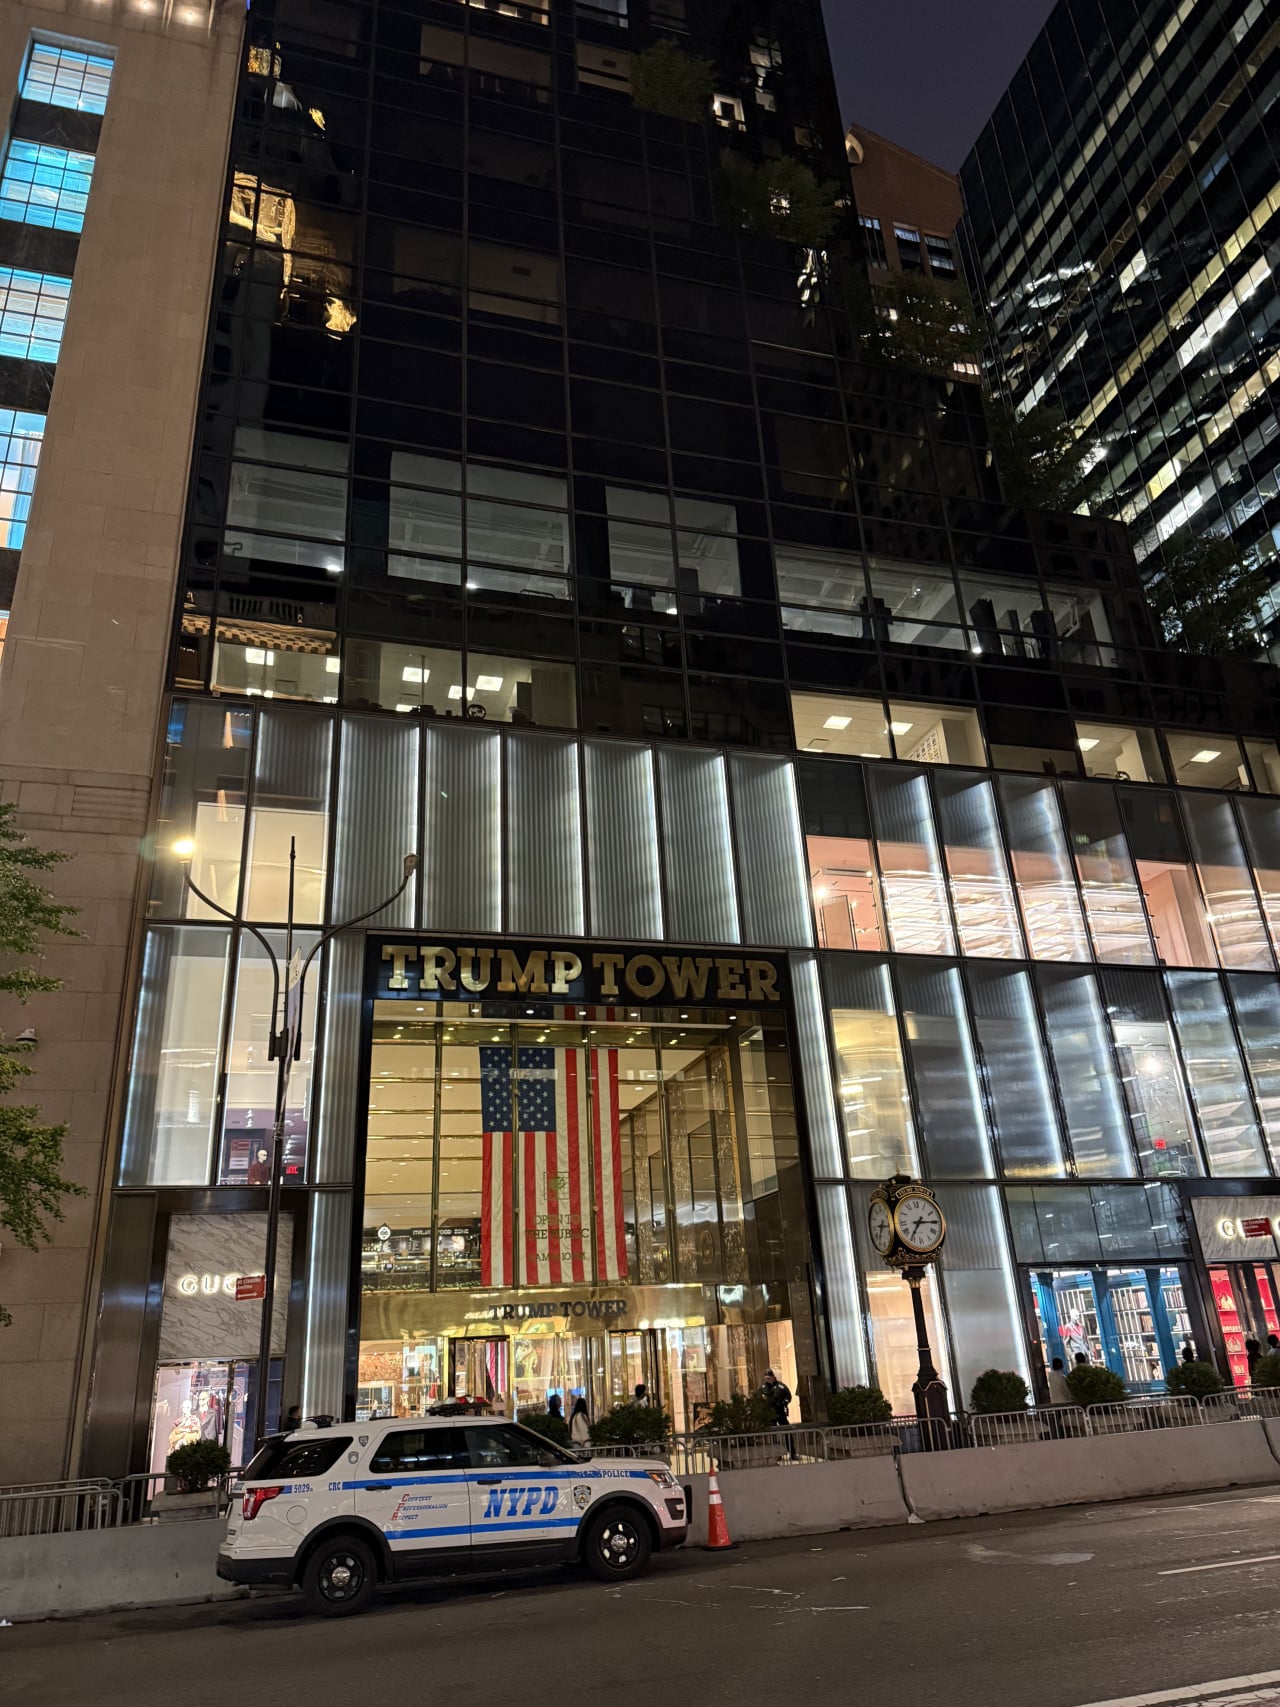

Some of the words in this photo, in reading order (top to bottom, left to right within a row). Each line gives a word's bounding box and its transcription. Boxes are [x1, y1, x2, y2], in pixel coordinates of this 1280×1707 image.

[382, 944, 582, 994] TRUMP
[592, 952, 781, 1001] TOWER
[525, 1229, 548, 1239] THE
[181, 1275, 238, 1293] GUC
[489, 1302, 557, 1320] TRUMP
[560, 1299, 628, 1318] TOWER
[602, 1470, 630, 1478] POLICE
[293, 1483, 310, 1493] 5029
[328, 1482, 342, 1491] CRC
[483, 1486, 559, 1518] NYPD
